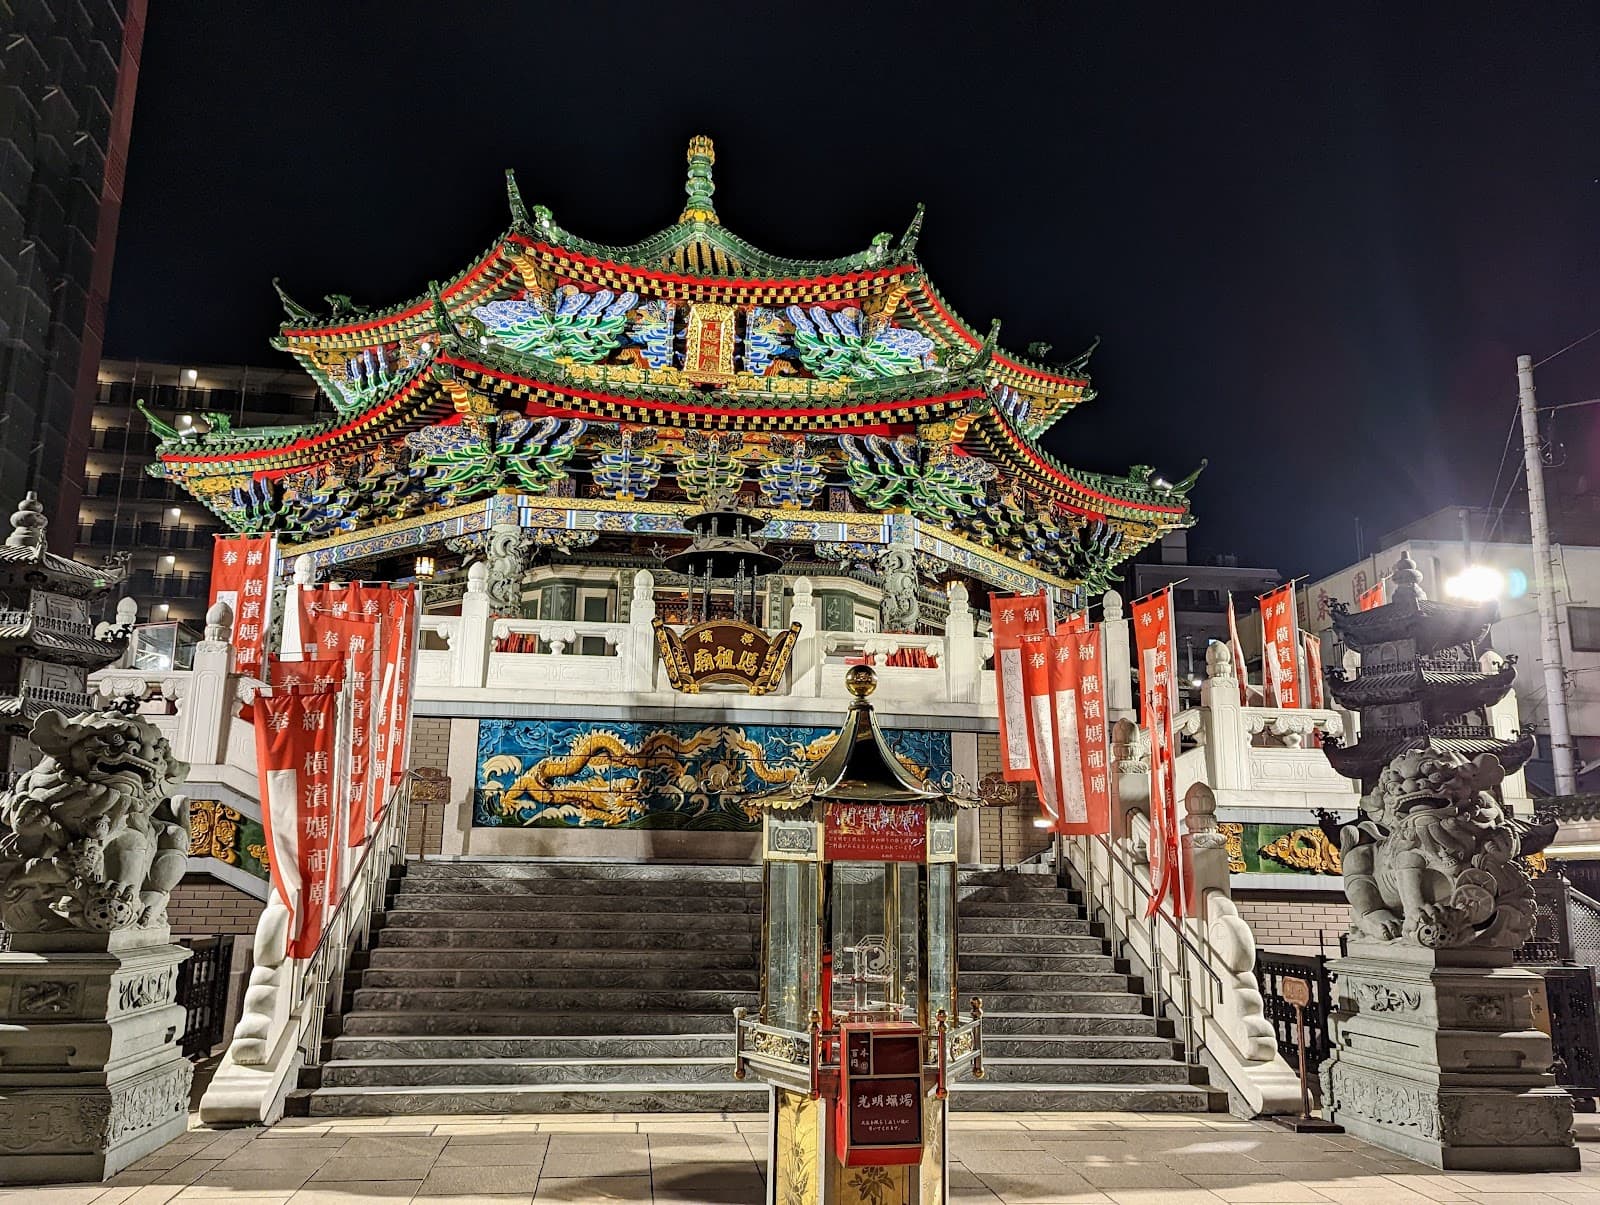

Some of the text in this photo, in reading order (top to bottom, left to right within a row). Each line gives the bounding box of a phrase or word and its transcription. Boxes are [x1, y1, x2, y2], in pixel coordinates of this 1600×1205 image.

[222, 549, 262, 567] 奉納
[999, 607, 1040, 625] 奉納
[323, 629, 367, 655] 奉納
[1055, 643, 1095, 663] 奉納
[267, 709, 327, 732] 奉納
[850, 1048, 860, 1068] 百円
